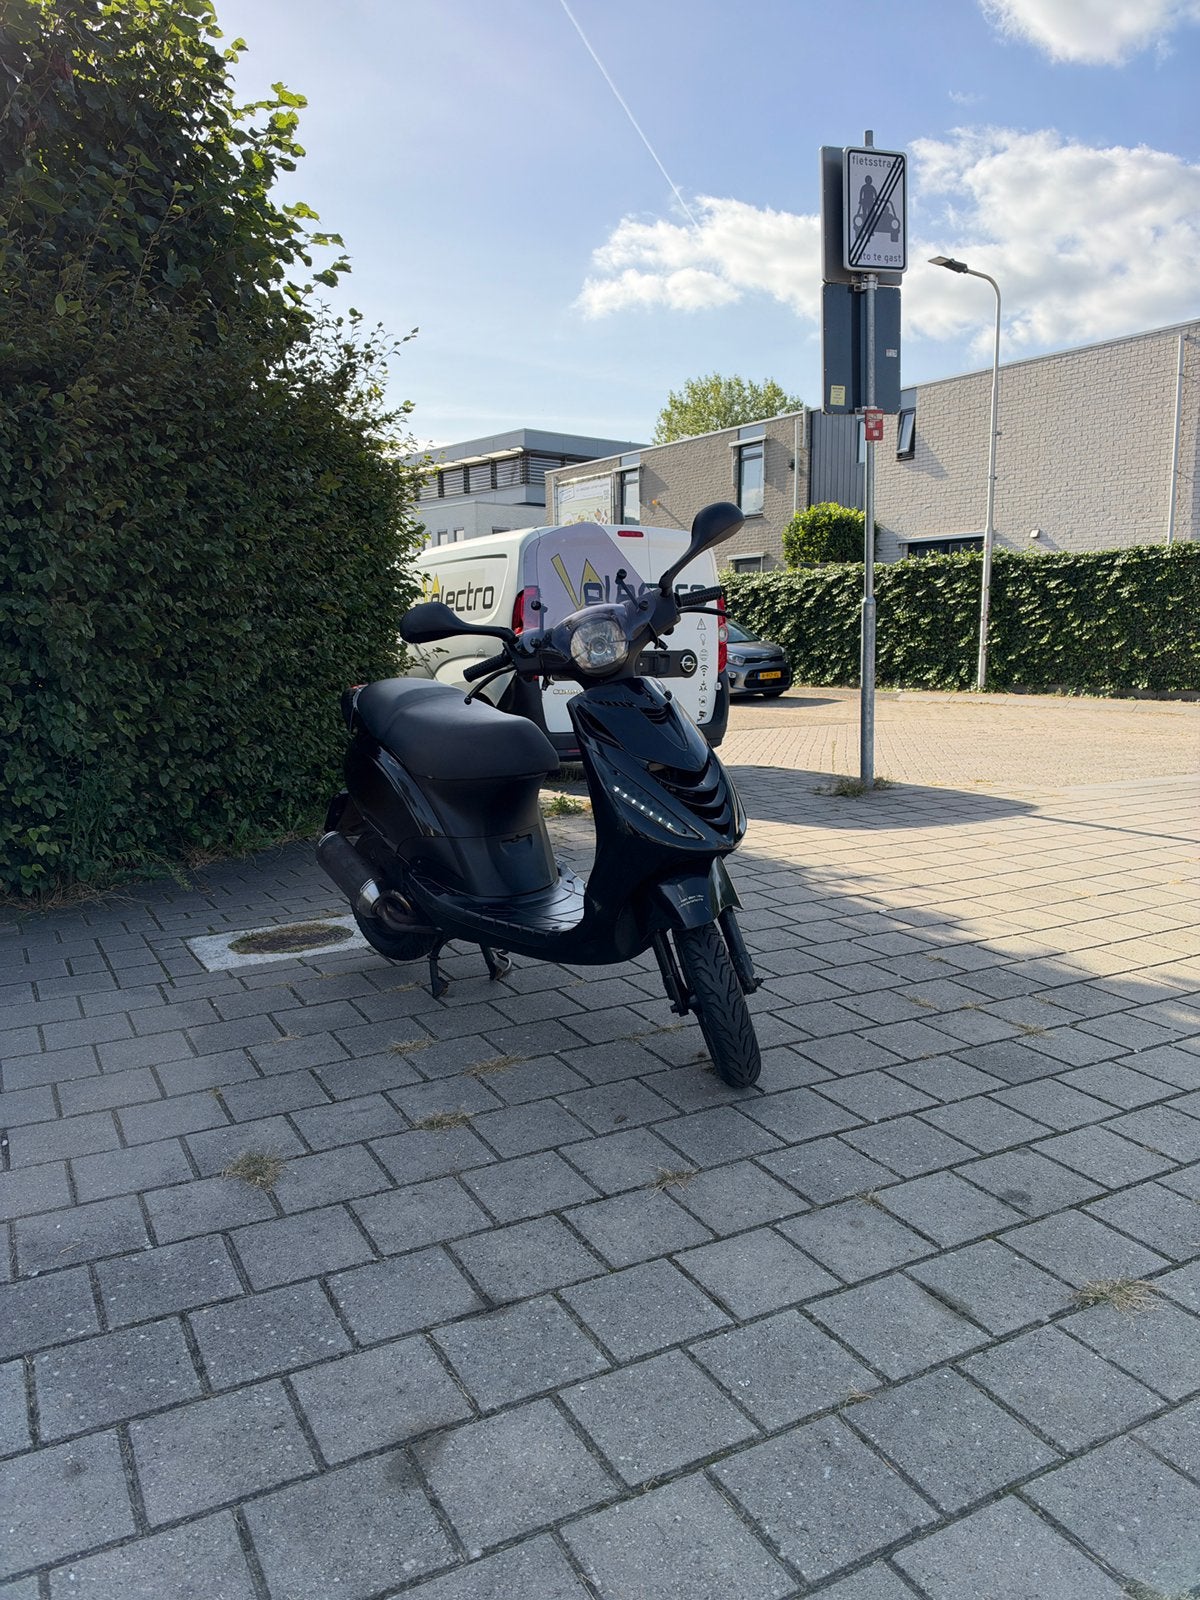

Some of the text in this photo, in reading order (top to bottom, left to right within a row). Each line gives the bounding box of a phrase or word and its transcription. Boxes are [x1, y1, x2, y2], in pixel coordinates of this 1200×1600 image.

[852, 155, 901, 169] fietsstra
[873, 253, 882, 261] te
[884, 254, 902, 264] gast
